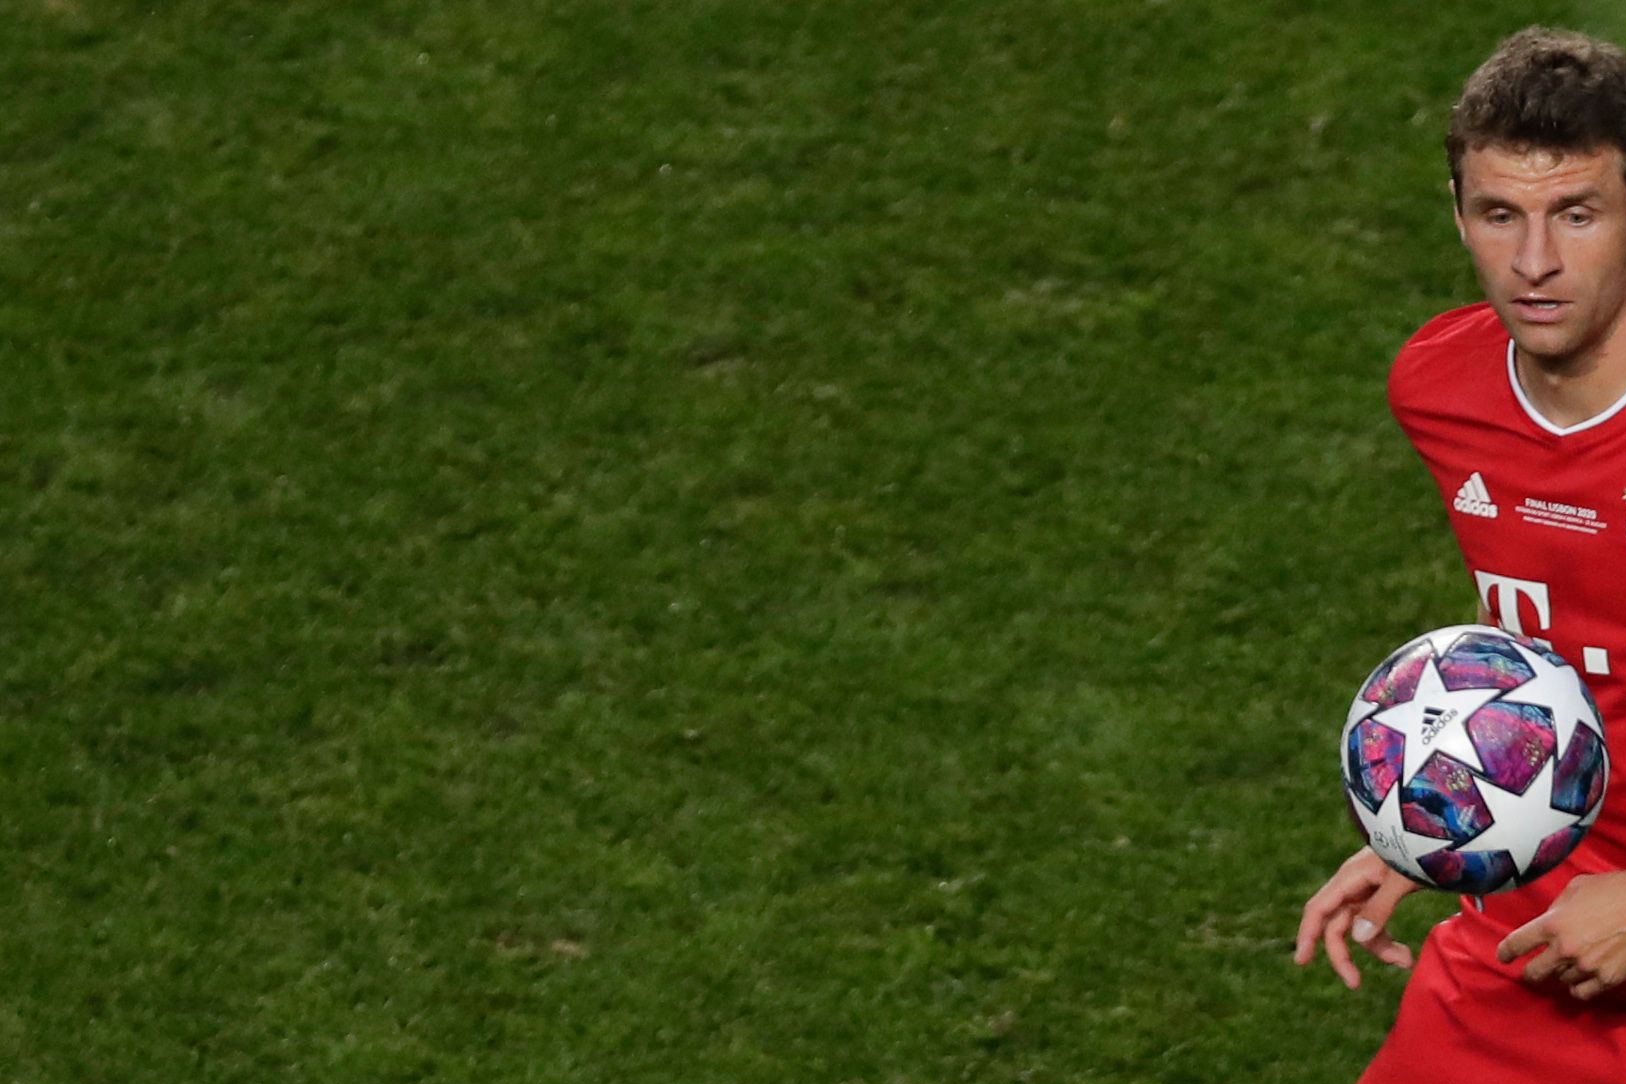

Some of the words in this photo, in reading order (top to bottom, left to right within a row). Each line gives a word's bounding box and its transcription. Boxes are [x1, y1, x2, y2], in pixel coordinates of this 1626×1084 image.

[1453, 496, 1498, 518] adidas
[1474, 570, 1553, 652] T
[1422, 708, 1458, 745] adidas
